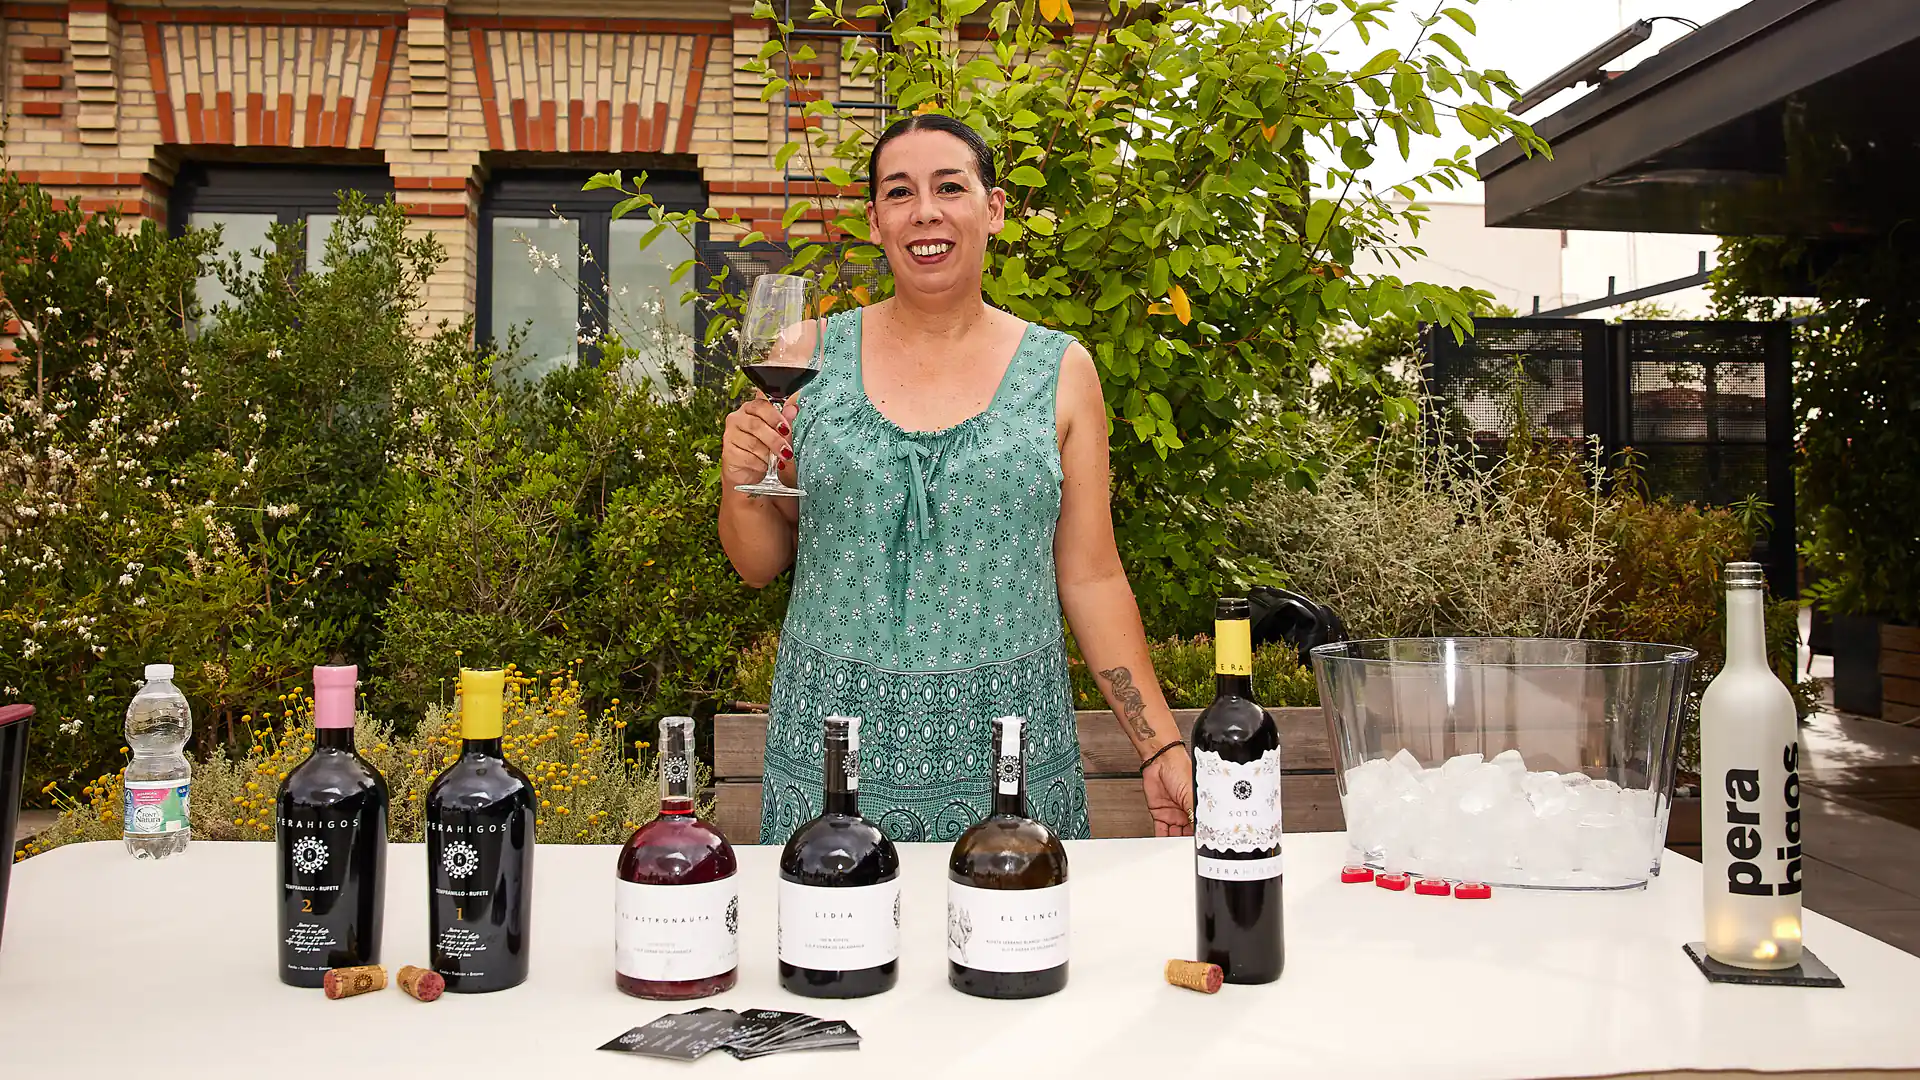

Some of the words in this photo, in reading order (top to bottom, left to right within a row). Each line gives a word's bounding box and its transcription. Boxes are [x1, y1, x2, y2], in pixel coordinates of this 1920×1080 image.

[1725, 768, 1774, 896] pera
[285, 883, 315, 891] TEMPRANILLO
[435, 888, 465, 896] TEMPRANILLO
[301, 899, 312, 912] 2
[456, 907, 463, 920] 1
[1024, 911, 1057, 921] LINCE
[634, 915, 709, 924] ASTRONAUTA
